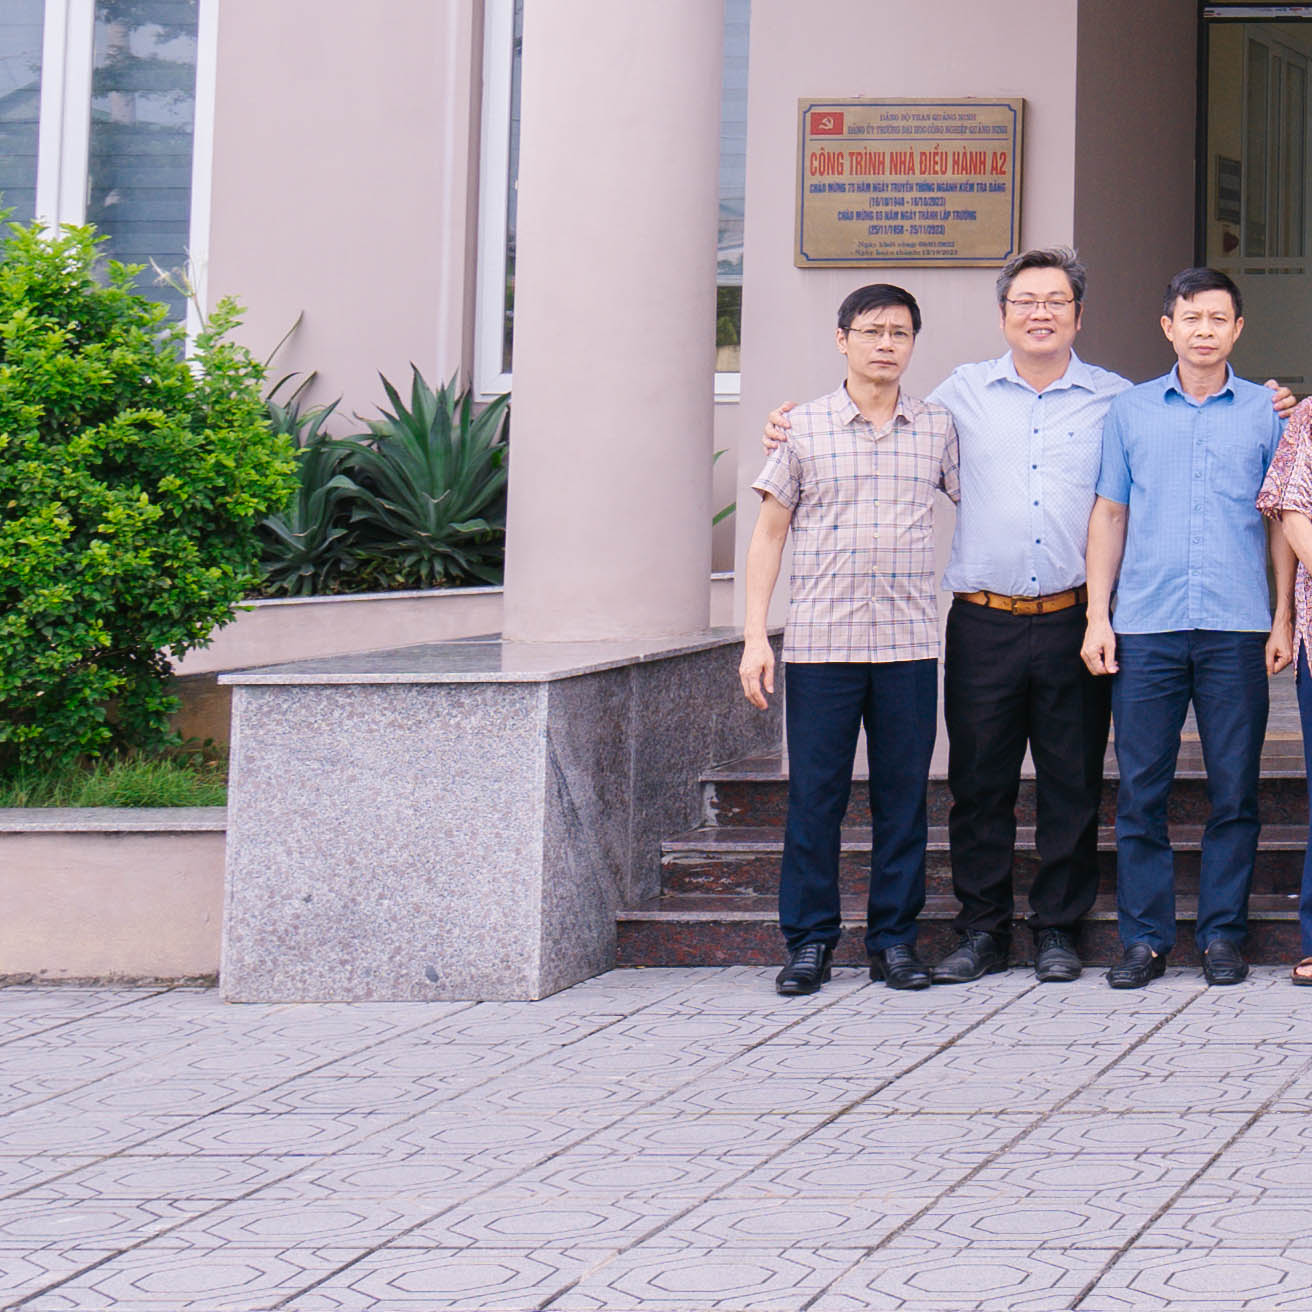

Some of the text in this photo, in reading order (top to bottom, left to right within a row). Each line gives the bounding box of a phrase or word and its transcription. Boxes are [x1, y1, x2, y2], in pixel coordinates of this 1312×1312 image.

[810, 147, 844, 176] CÔNG
[848, 146, 886, 176] TRÌNH
[889, 146, 915, 176] NHÀ
[952, 146, 986, 175] HÀNH
[990, 152, 1007, 175] A2
